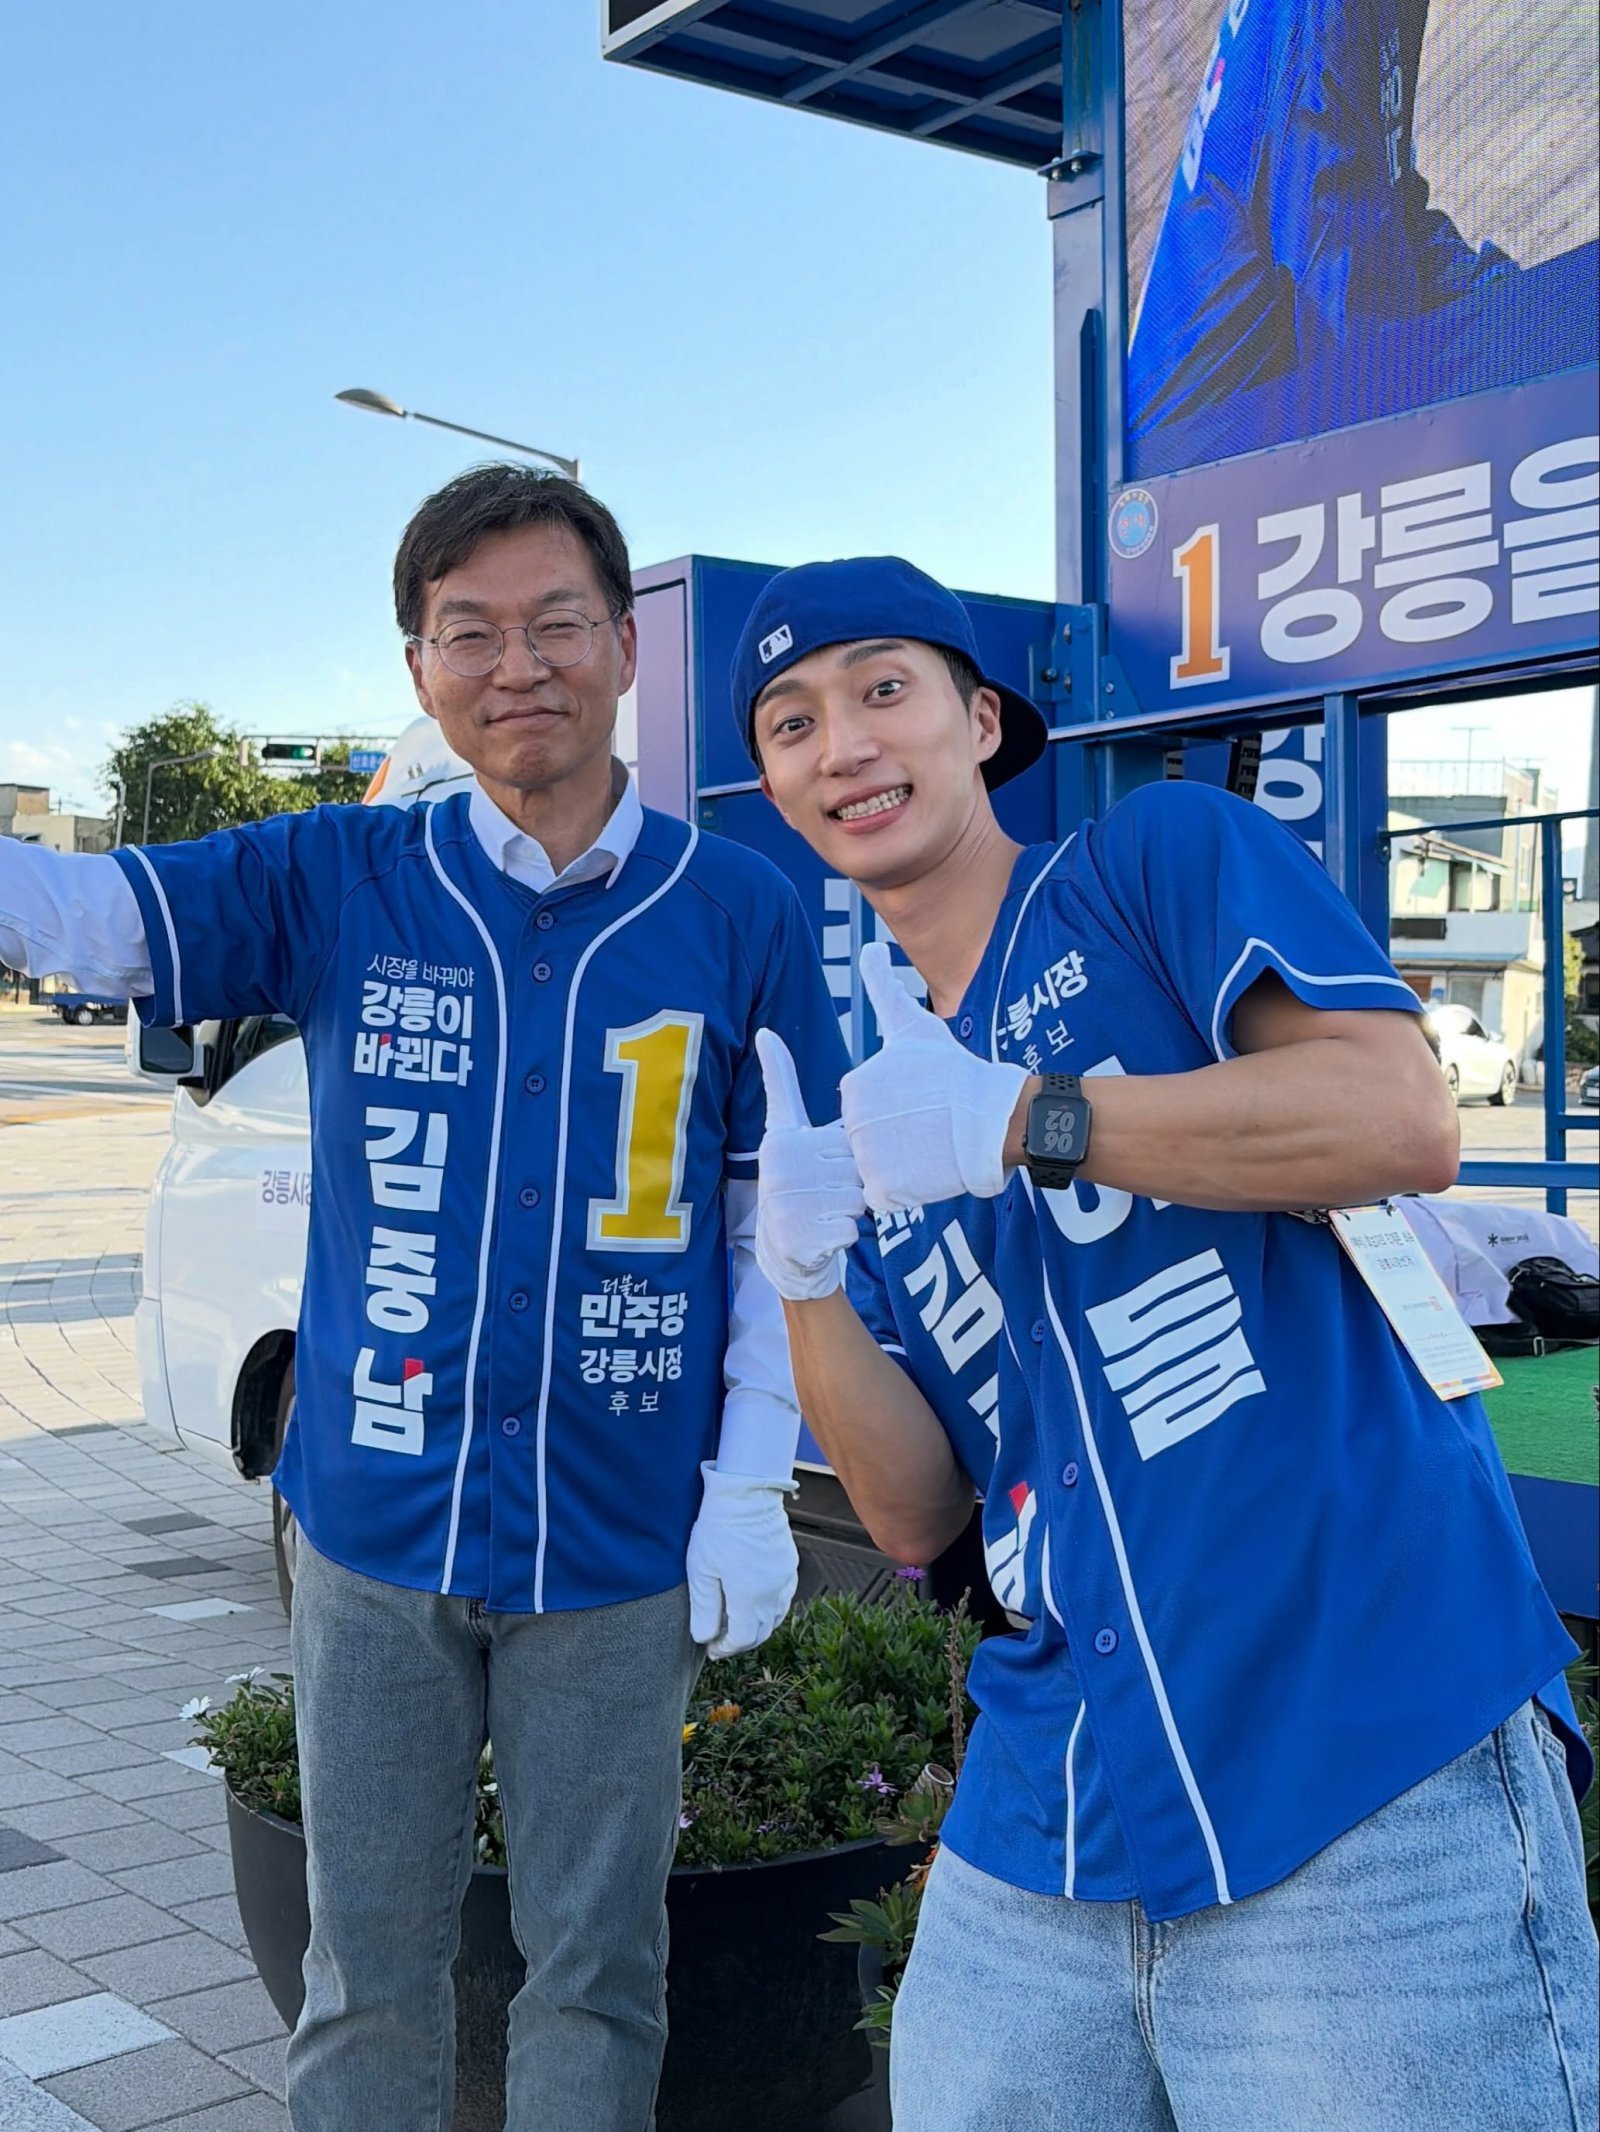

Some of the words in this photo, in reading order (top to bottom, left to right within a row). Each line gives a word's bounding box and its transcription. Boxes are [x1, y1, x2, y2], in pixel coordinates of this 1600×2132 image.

[1170, 522, 1230, 690] 1
[1257, 435, 1599, 664] 강릉을
[366, 953, 419, 980] 시장을
[422, 962, 475, 988] 바꿔야
[361, 980, 473, 1039] 강릉이
[996, 949, 1088, 1051] 릉시장
[353, 1032, 474, 1087] 바뀐다
[585, 1008, 704, 1253] 1
[351, 1106, 448, 1456] 김중남
[601, 1273, 648, 1298] 더불어
[580, 1292, 688, 1338] 민주당
[579, 1344, 683, 1384] 강릉시장
